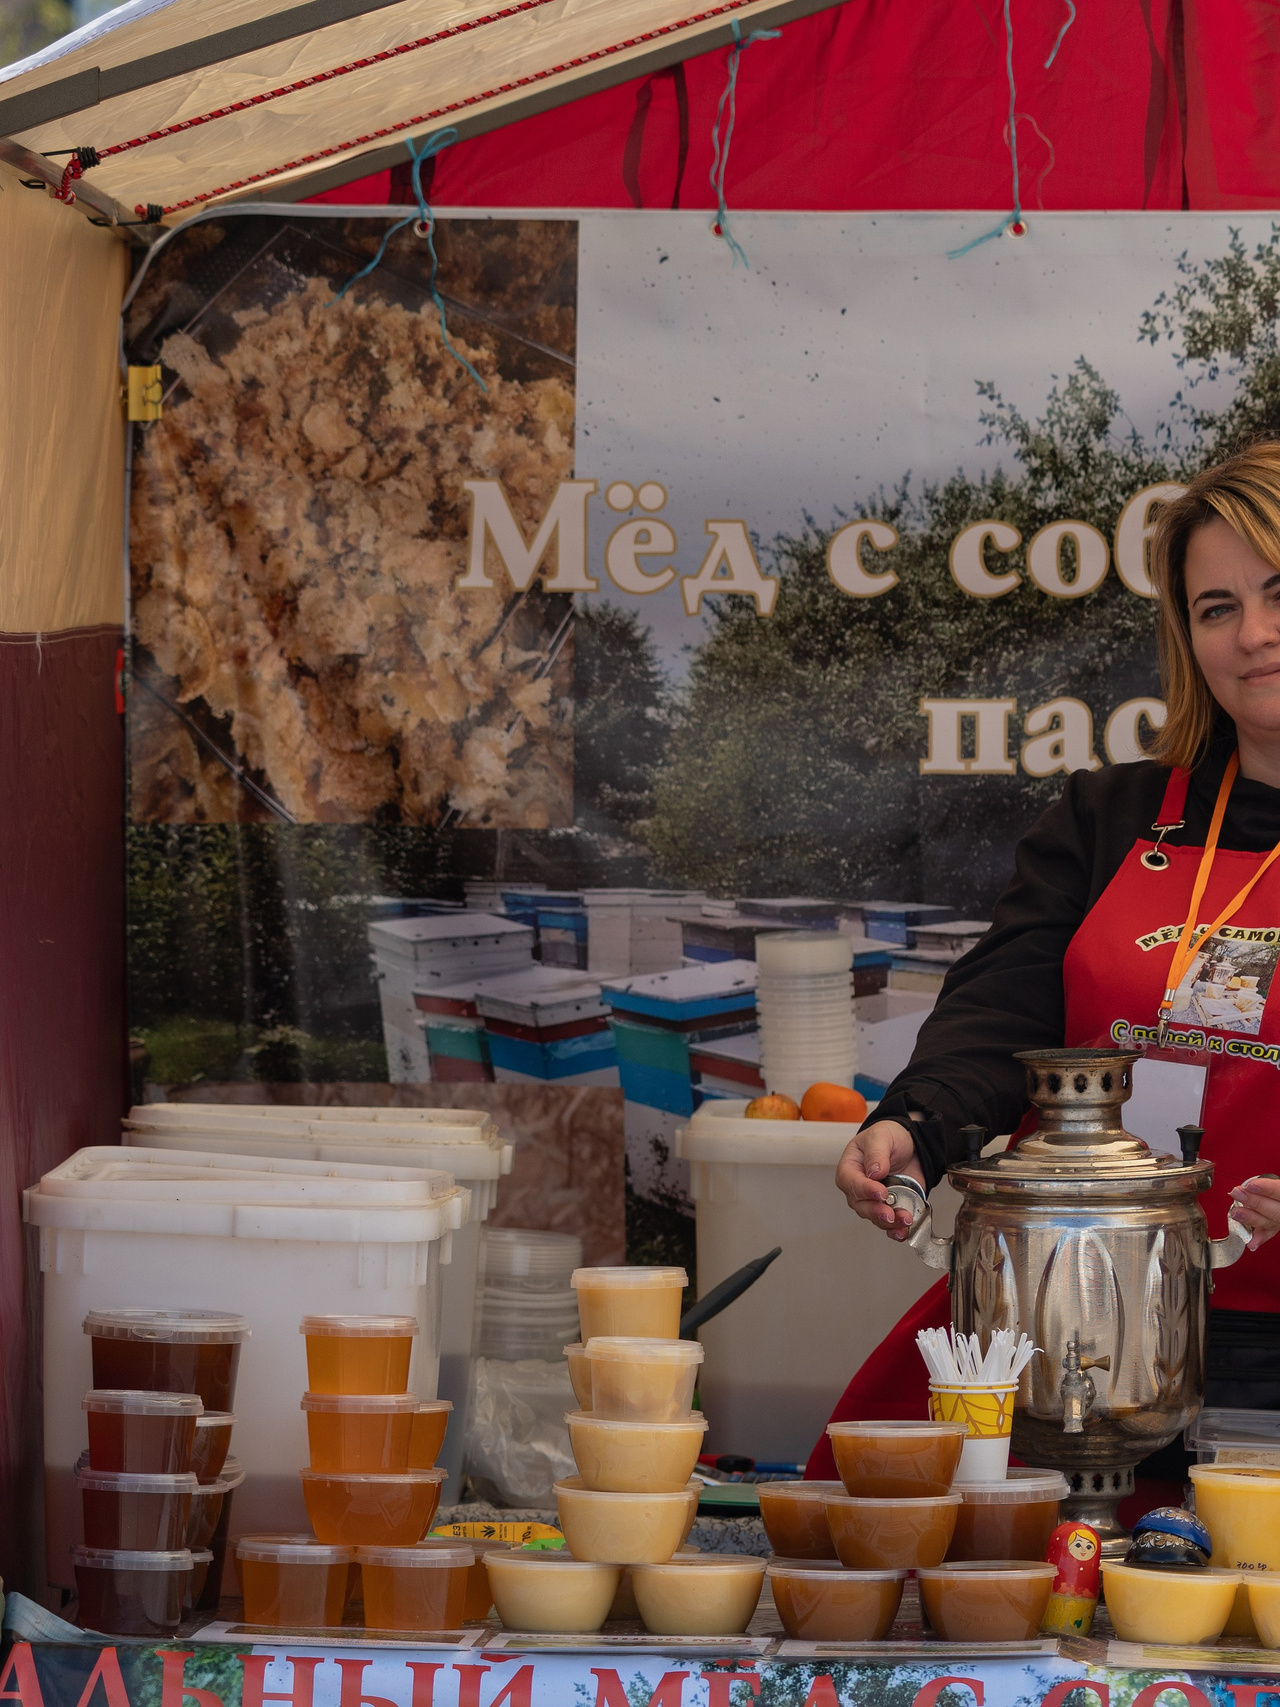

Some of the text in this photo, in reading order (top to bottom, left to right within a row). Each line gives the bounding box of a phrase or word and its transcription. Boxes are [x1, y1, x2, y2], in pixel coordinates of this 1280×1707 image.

[458, 480, 779, 618] Мёд
[826, 519, 900, 599] с
[1112, 1023, 1128, 1041] С
[1209, 1039, 1221, 1051] к
